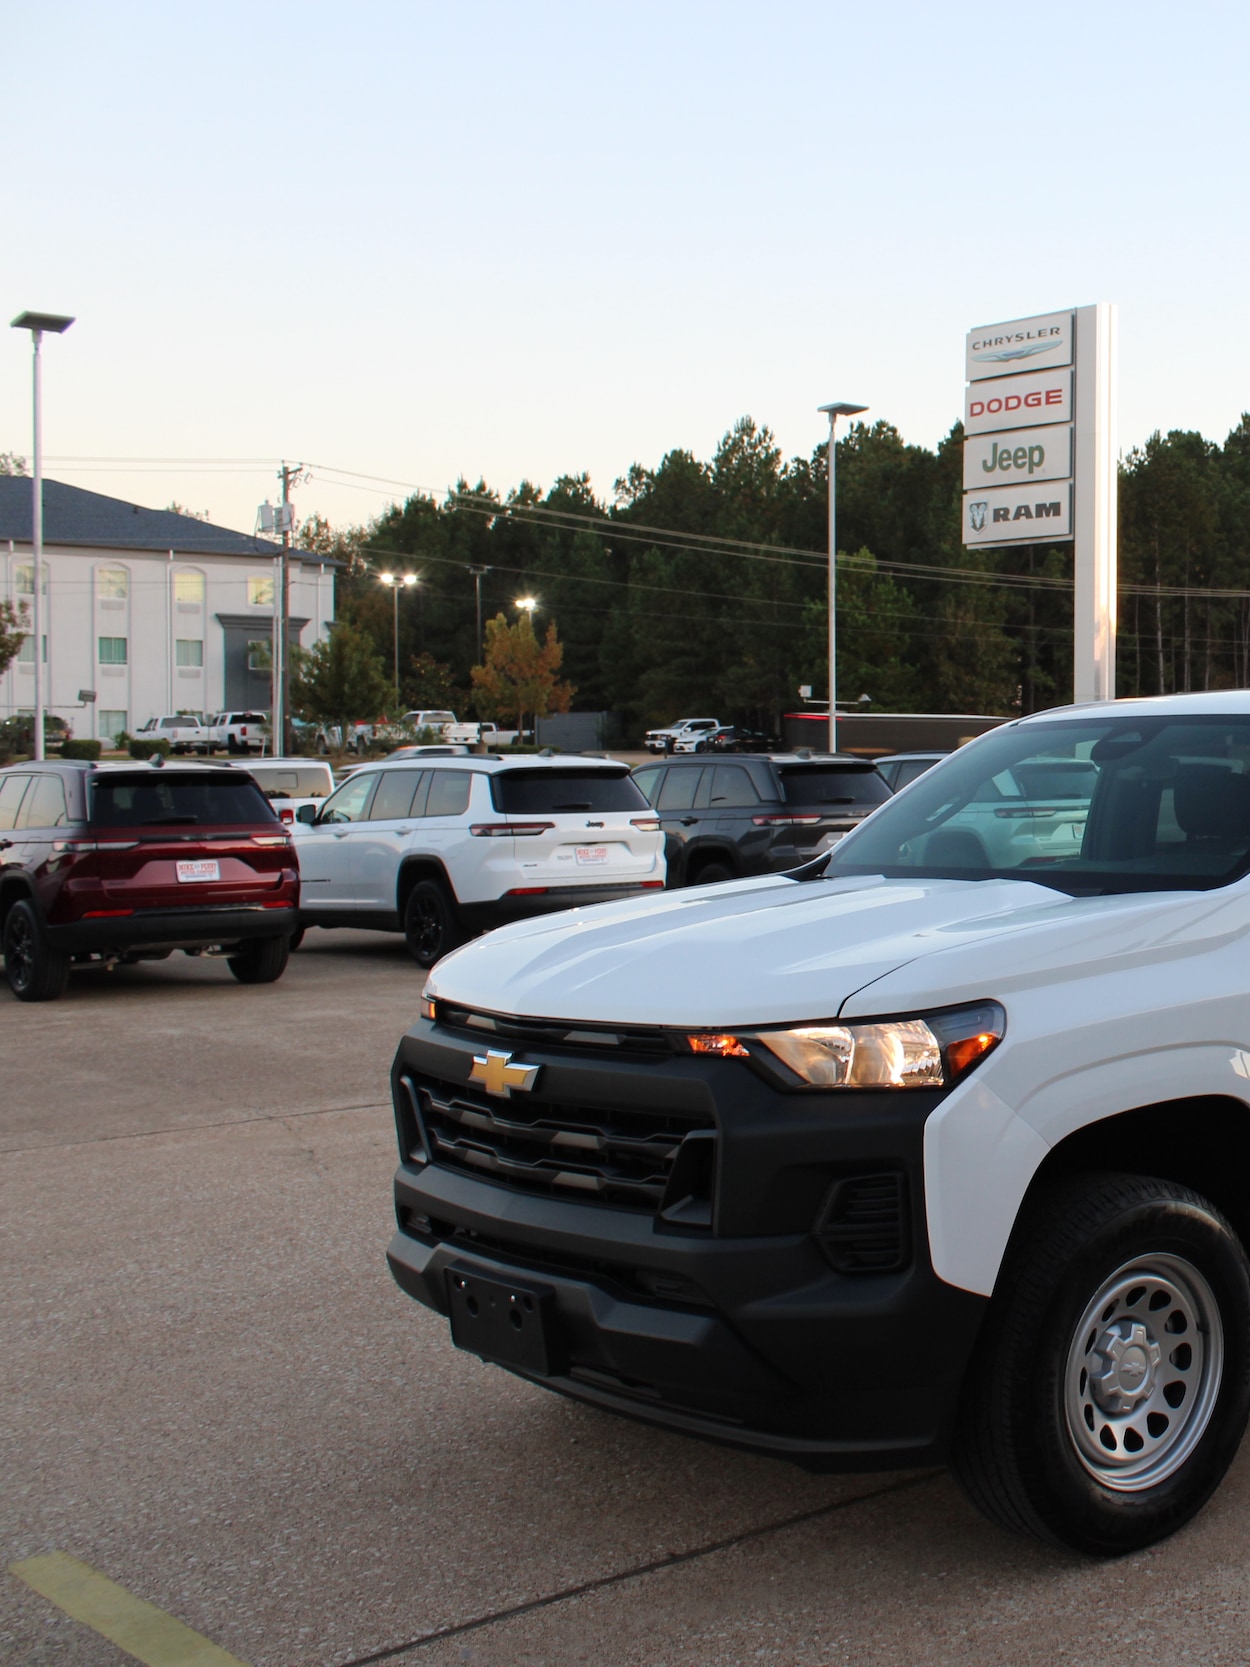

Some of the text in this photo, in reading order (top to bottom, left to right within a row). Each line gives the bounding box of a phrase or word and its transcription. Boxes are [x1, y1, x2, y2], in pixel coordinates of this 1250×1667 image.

[971, 326, 1061, 351] CHRYSLER
[969, 388, 1063, 417] DODGE
[982, 442, 1045, 474] Jeep
[993, 501, 1061, 523] RAM
[586, 820, 604, 828] Jeep
